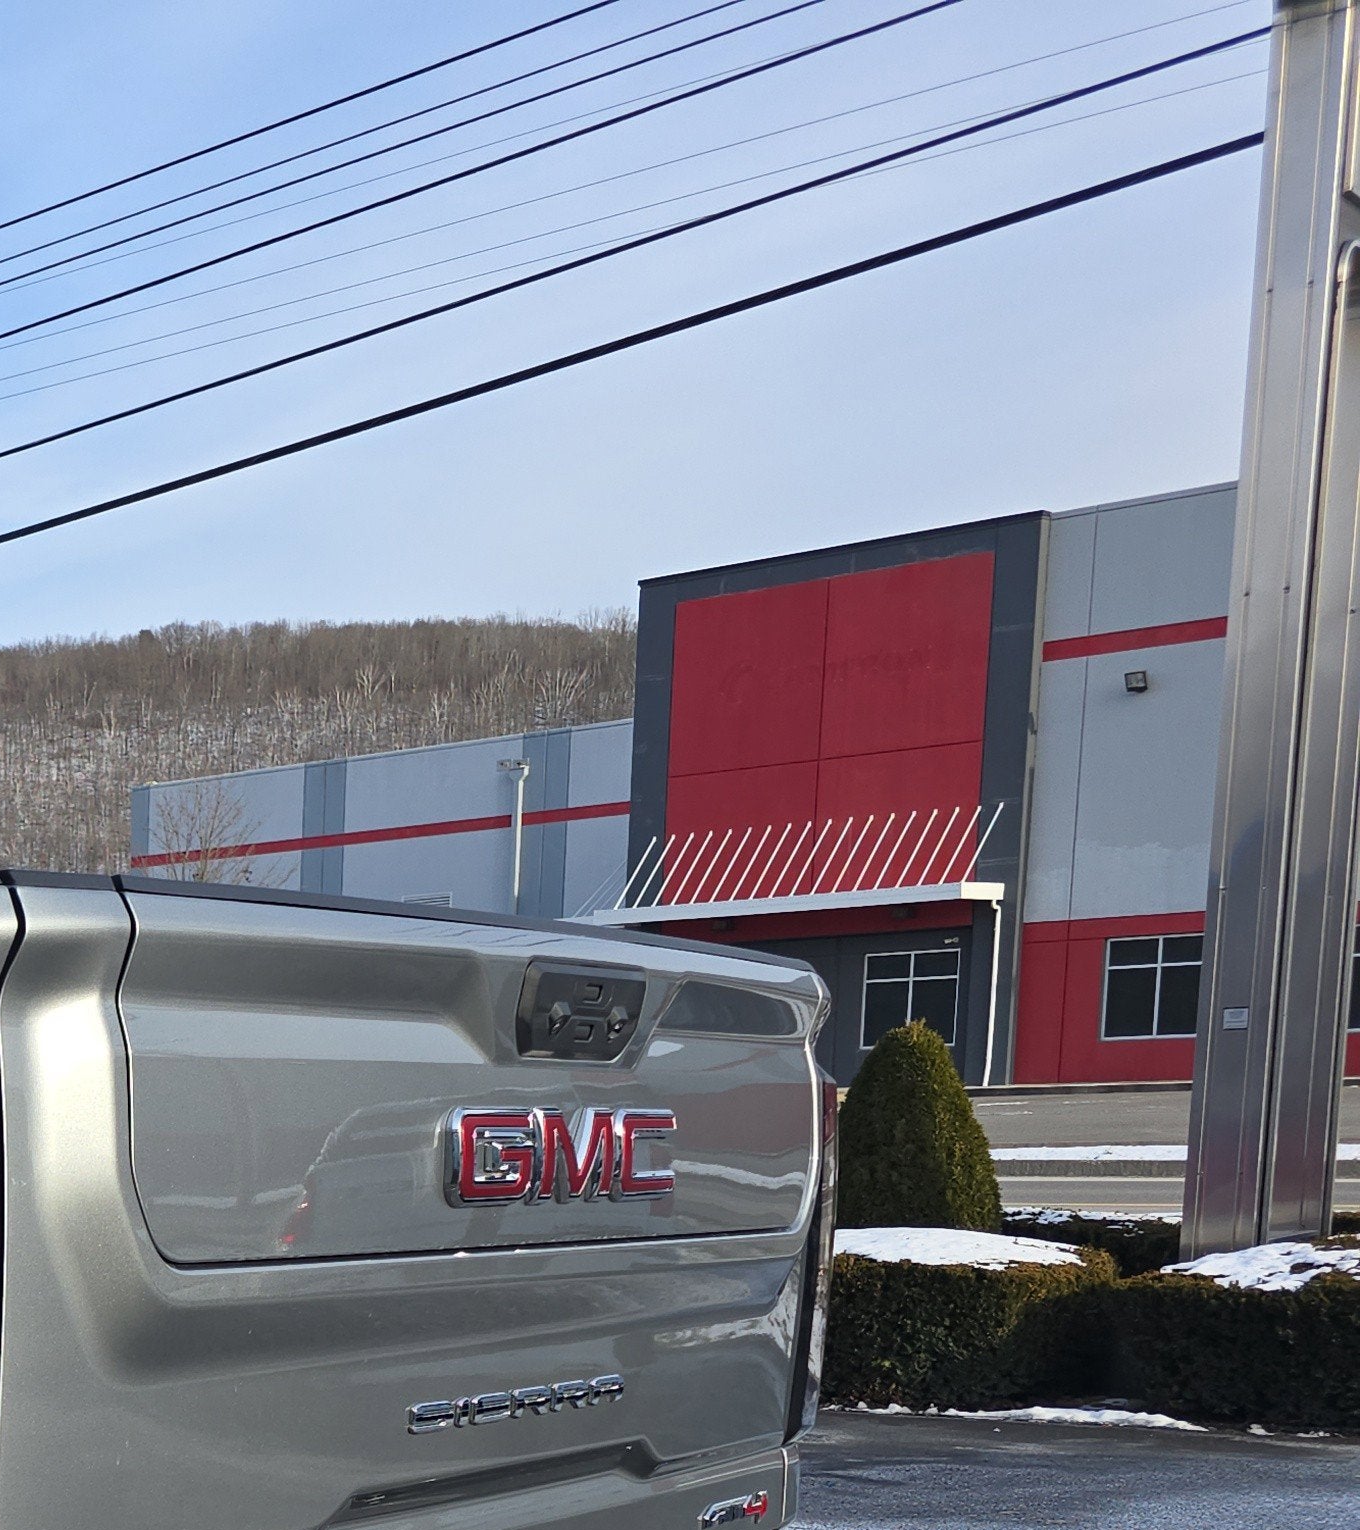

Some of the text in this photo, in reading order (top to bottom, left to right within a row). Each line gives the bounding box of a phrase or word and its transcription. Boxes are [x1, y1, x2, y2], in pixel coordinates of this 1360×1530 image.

[443, 1106, 677, 1208] GMC
[406, 1373, 625, 1435] SIERRA
[697, 1490, 769, 1530] AT4
